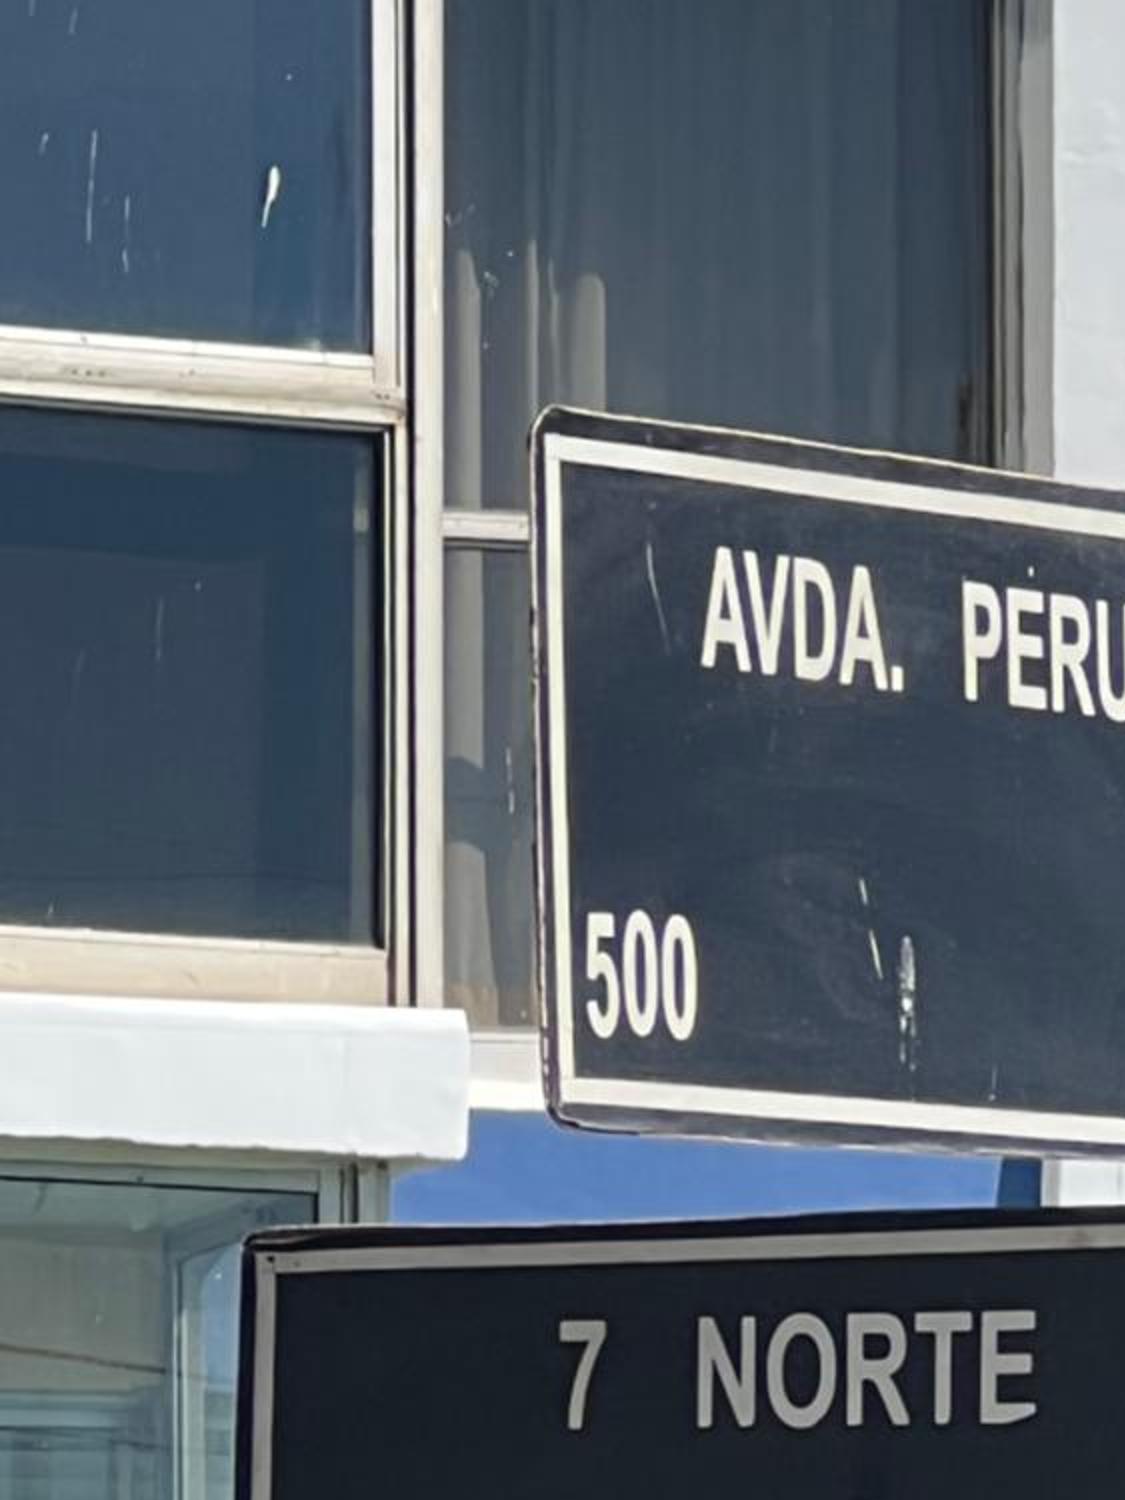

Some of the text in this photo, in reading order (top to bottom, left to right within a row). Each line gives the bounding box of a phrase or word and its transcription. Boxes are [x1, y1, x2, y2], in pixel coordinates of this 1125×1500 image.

[700, 545, 905, 693] AVDA.
[585, 908, 699, 1042] 500
[560, 1310, 1037, 1430] 7 NORTE
